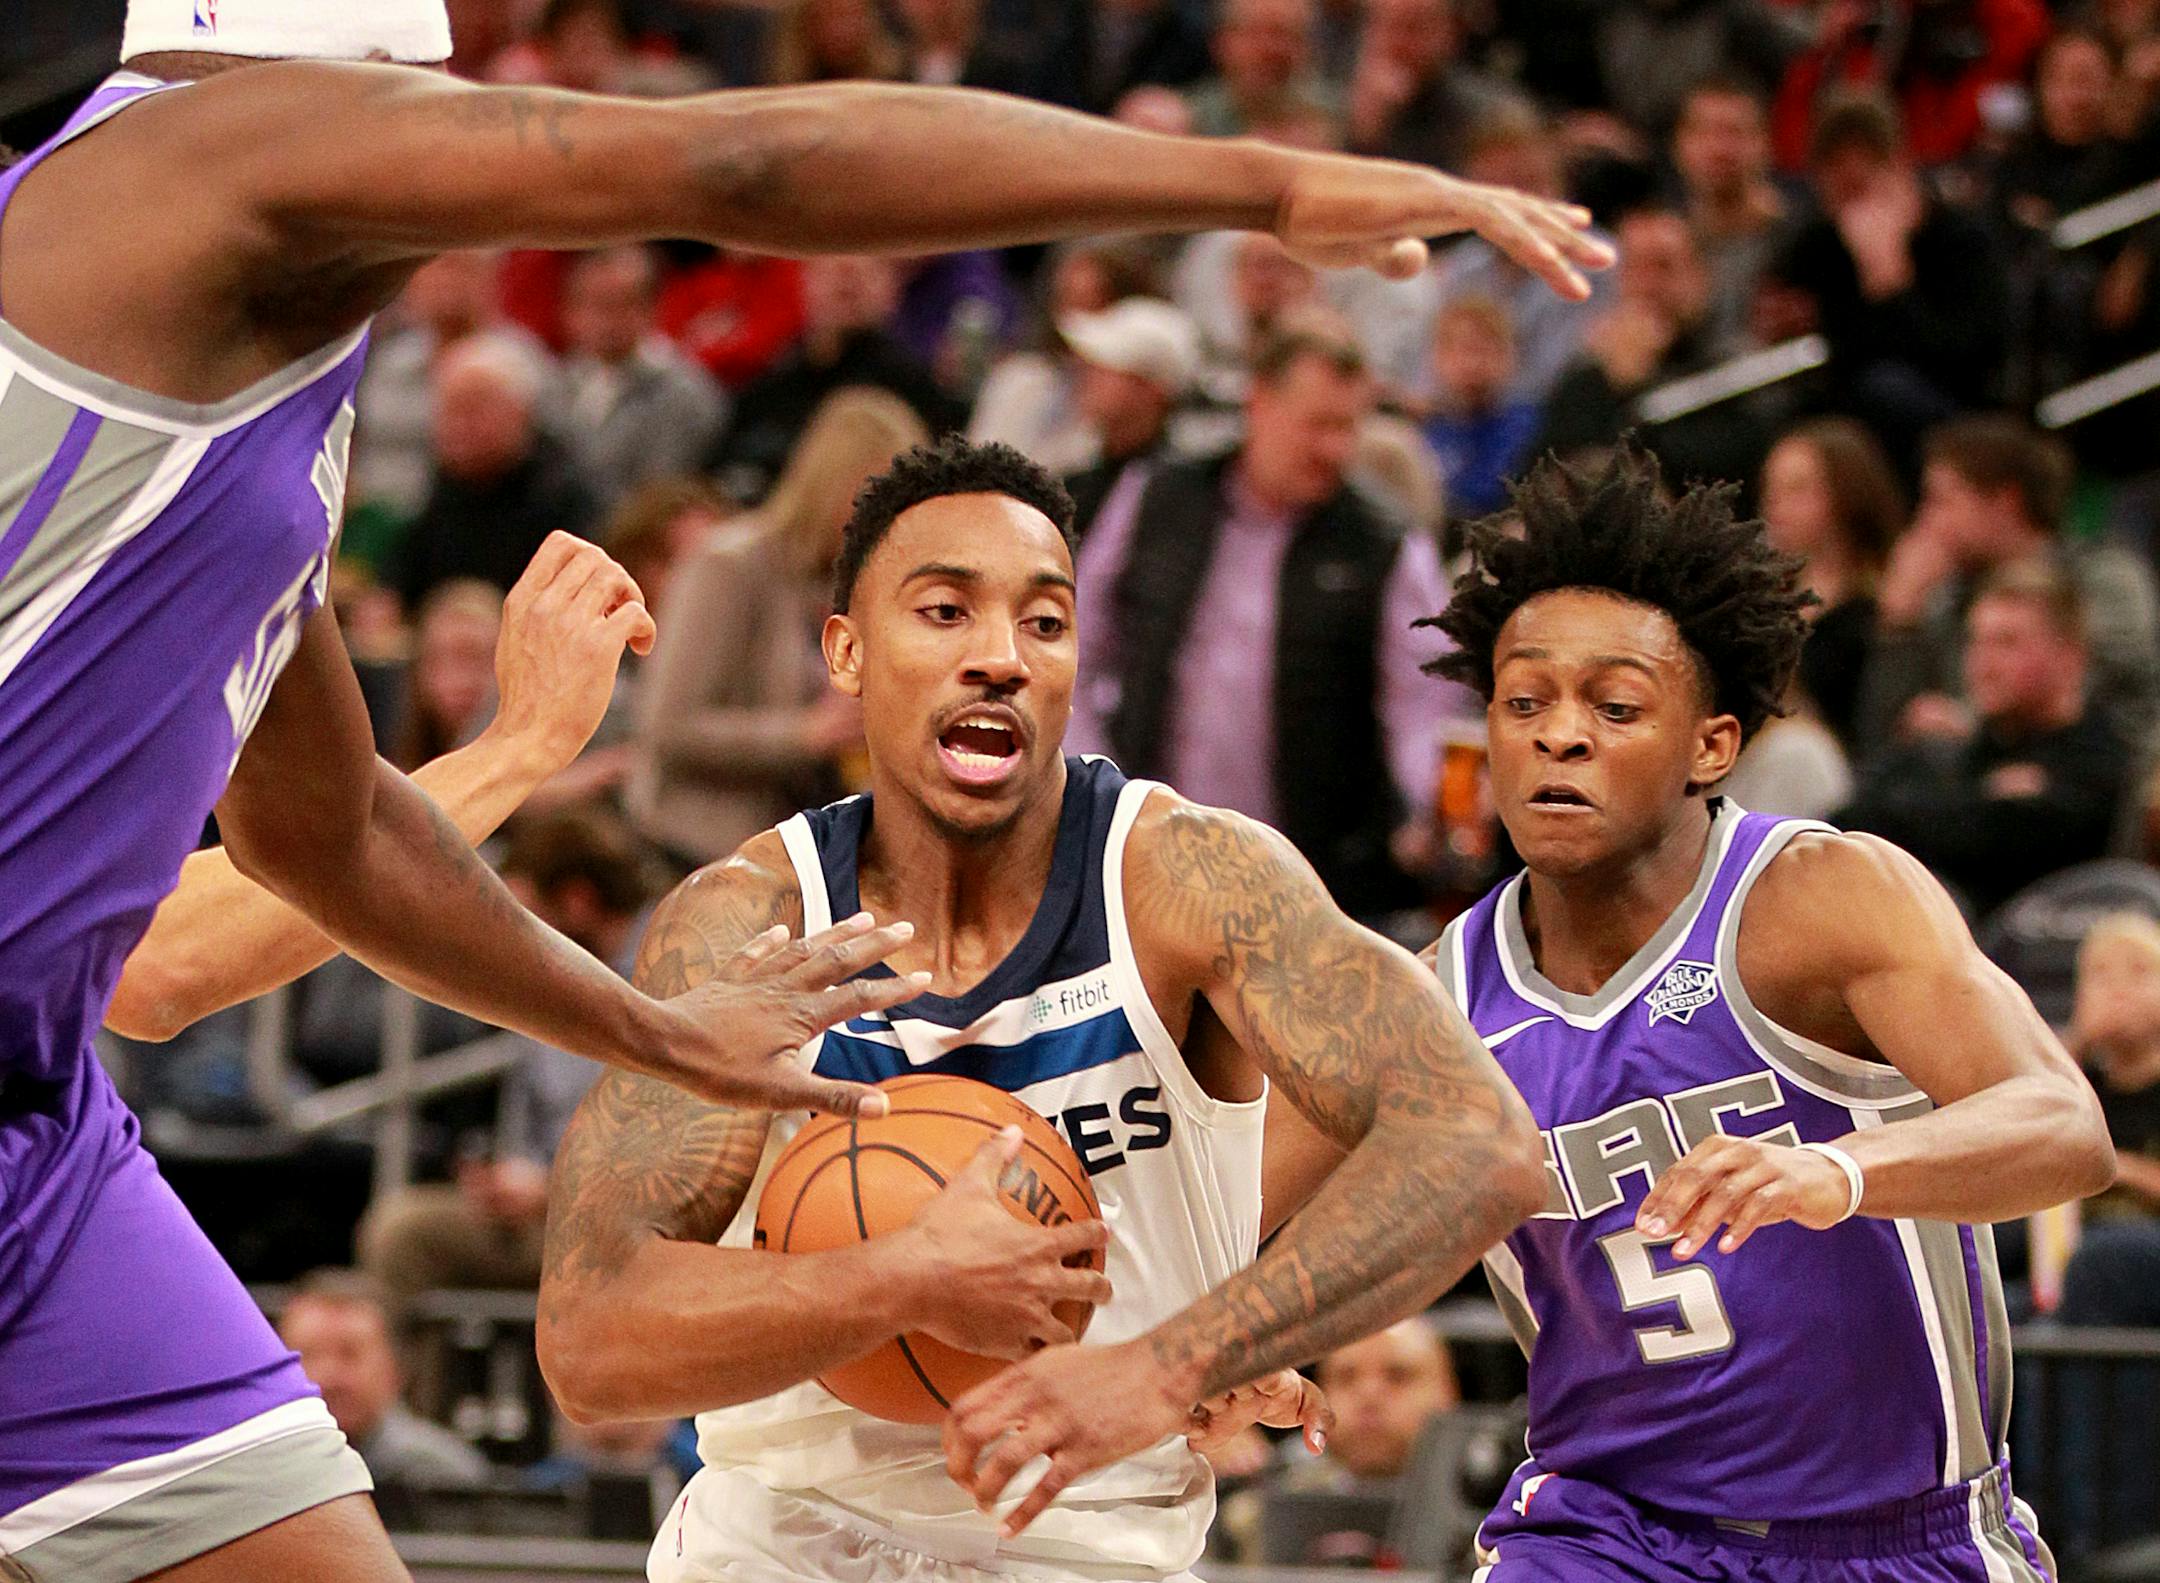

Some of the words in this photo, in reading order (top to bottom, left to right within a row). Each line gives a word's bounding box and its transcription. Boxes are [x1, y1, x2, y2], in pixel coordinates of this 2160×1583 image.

[1059, 979, 1110, 1016] fitbit
[1652, 970, 1710, 1002] DIAMOND
[1655, 991, 1712, 1016] ALMONDS
[1046, 1086, 1172, 1177] ES
[1529, 1069, 1802, 1221] AC
[1596, 1226, 1735, 1365] 5
